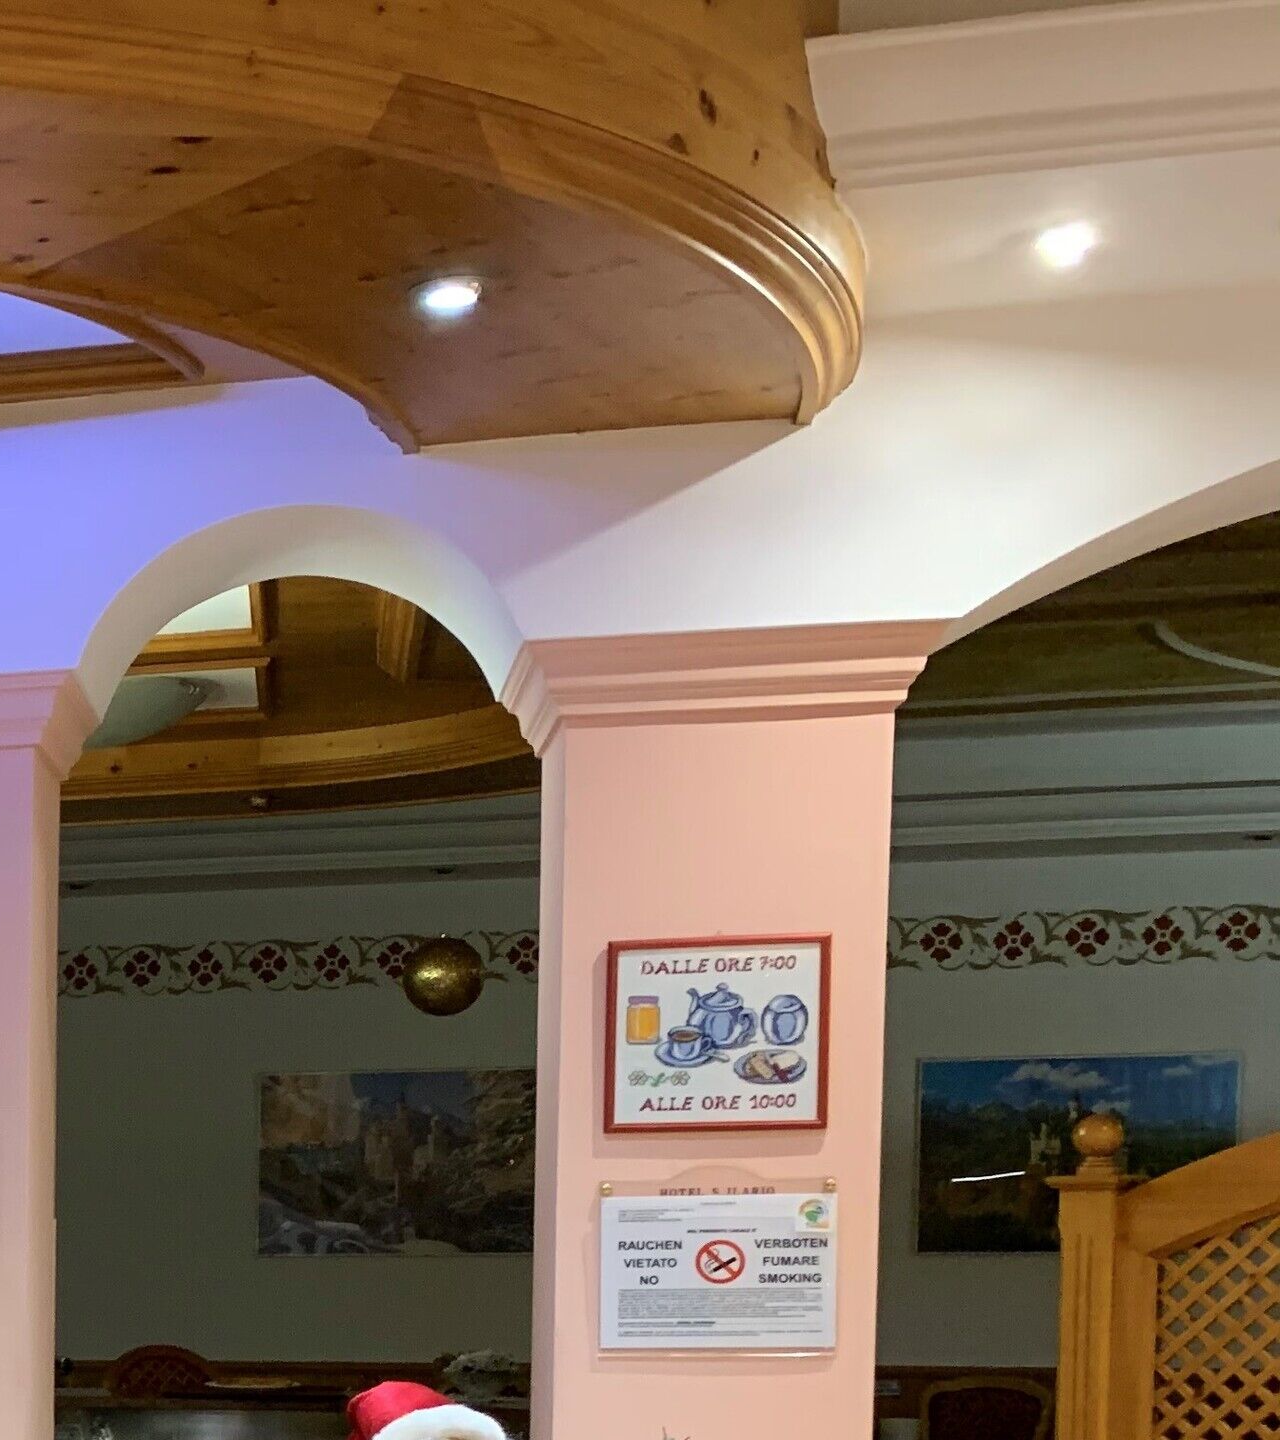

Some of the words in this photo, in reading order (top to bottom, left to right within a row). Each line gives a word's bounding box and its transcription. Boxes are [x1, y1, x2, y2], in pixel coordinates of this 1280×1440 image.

[641, 958, 710, 975] DALLE
[714, 957, 755, 973] ORE
[760, 955, 797, 971] 7:00
[639, 1097, 694, 1112] ALLE
[701, 1095, 741, 1110] ORE
[749, 1094, 797, 1110] 10:00
[618, 1240, 683, 1251] RAUCHEN
[754, 1238, 828, 1249] VERBOTEN
[624, 1258, 677, 1268] VIETATO
[762, 1256, 820, 1266] FUMARE
[640, 1275, 659, 1285] NO
[758, 1274, 822, 1285] SMOKING
